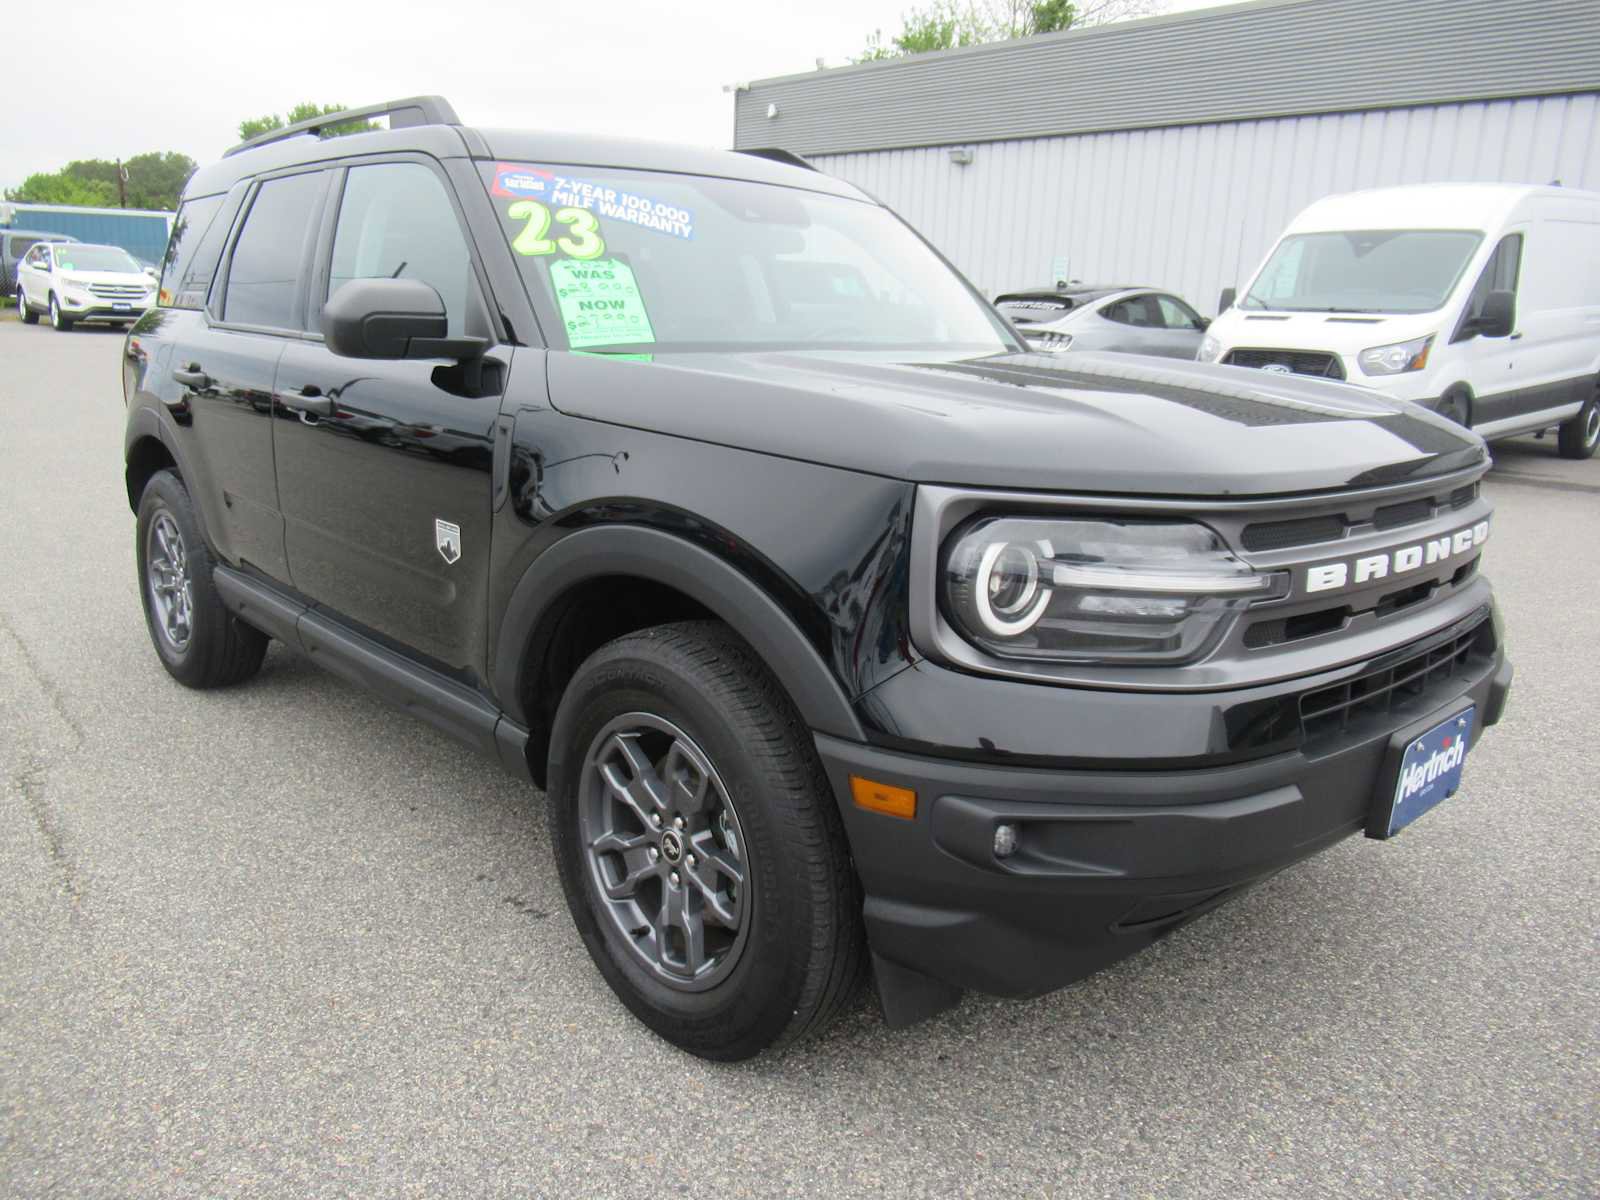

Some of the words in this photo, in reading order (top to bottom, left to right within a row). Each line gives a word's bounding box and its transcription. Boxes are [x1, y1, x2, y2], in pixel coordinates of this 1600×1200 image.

[554, 176, 617, 203] 7-YEAR
[508, 201, 605, 260] 23
[551, 190, 594, 209] MILE
[599, 199, 693, 238] WARRANTY
[571, 269, 615, 280] WAS
[579, 300, 626, 311] NOW
[1306, 520, 1489, 593] BRONCO
